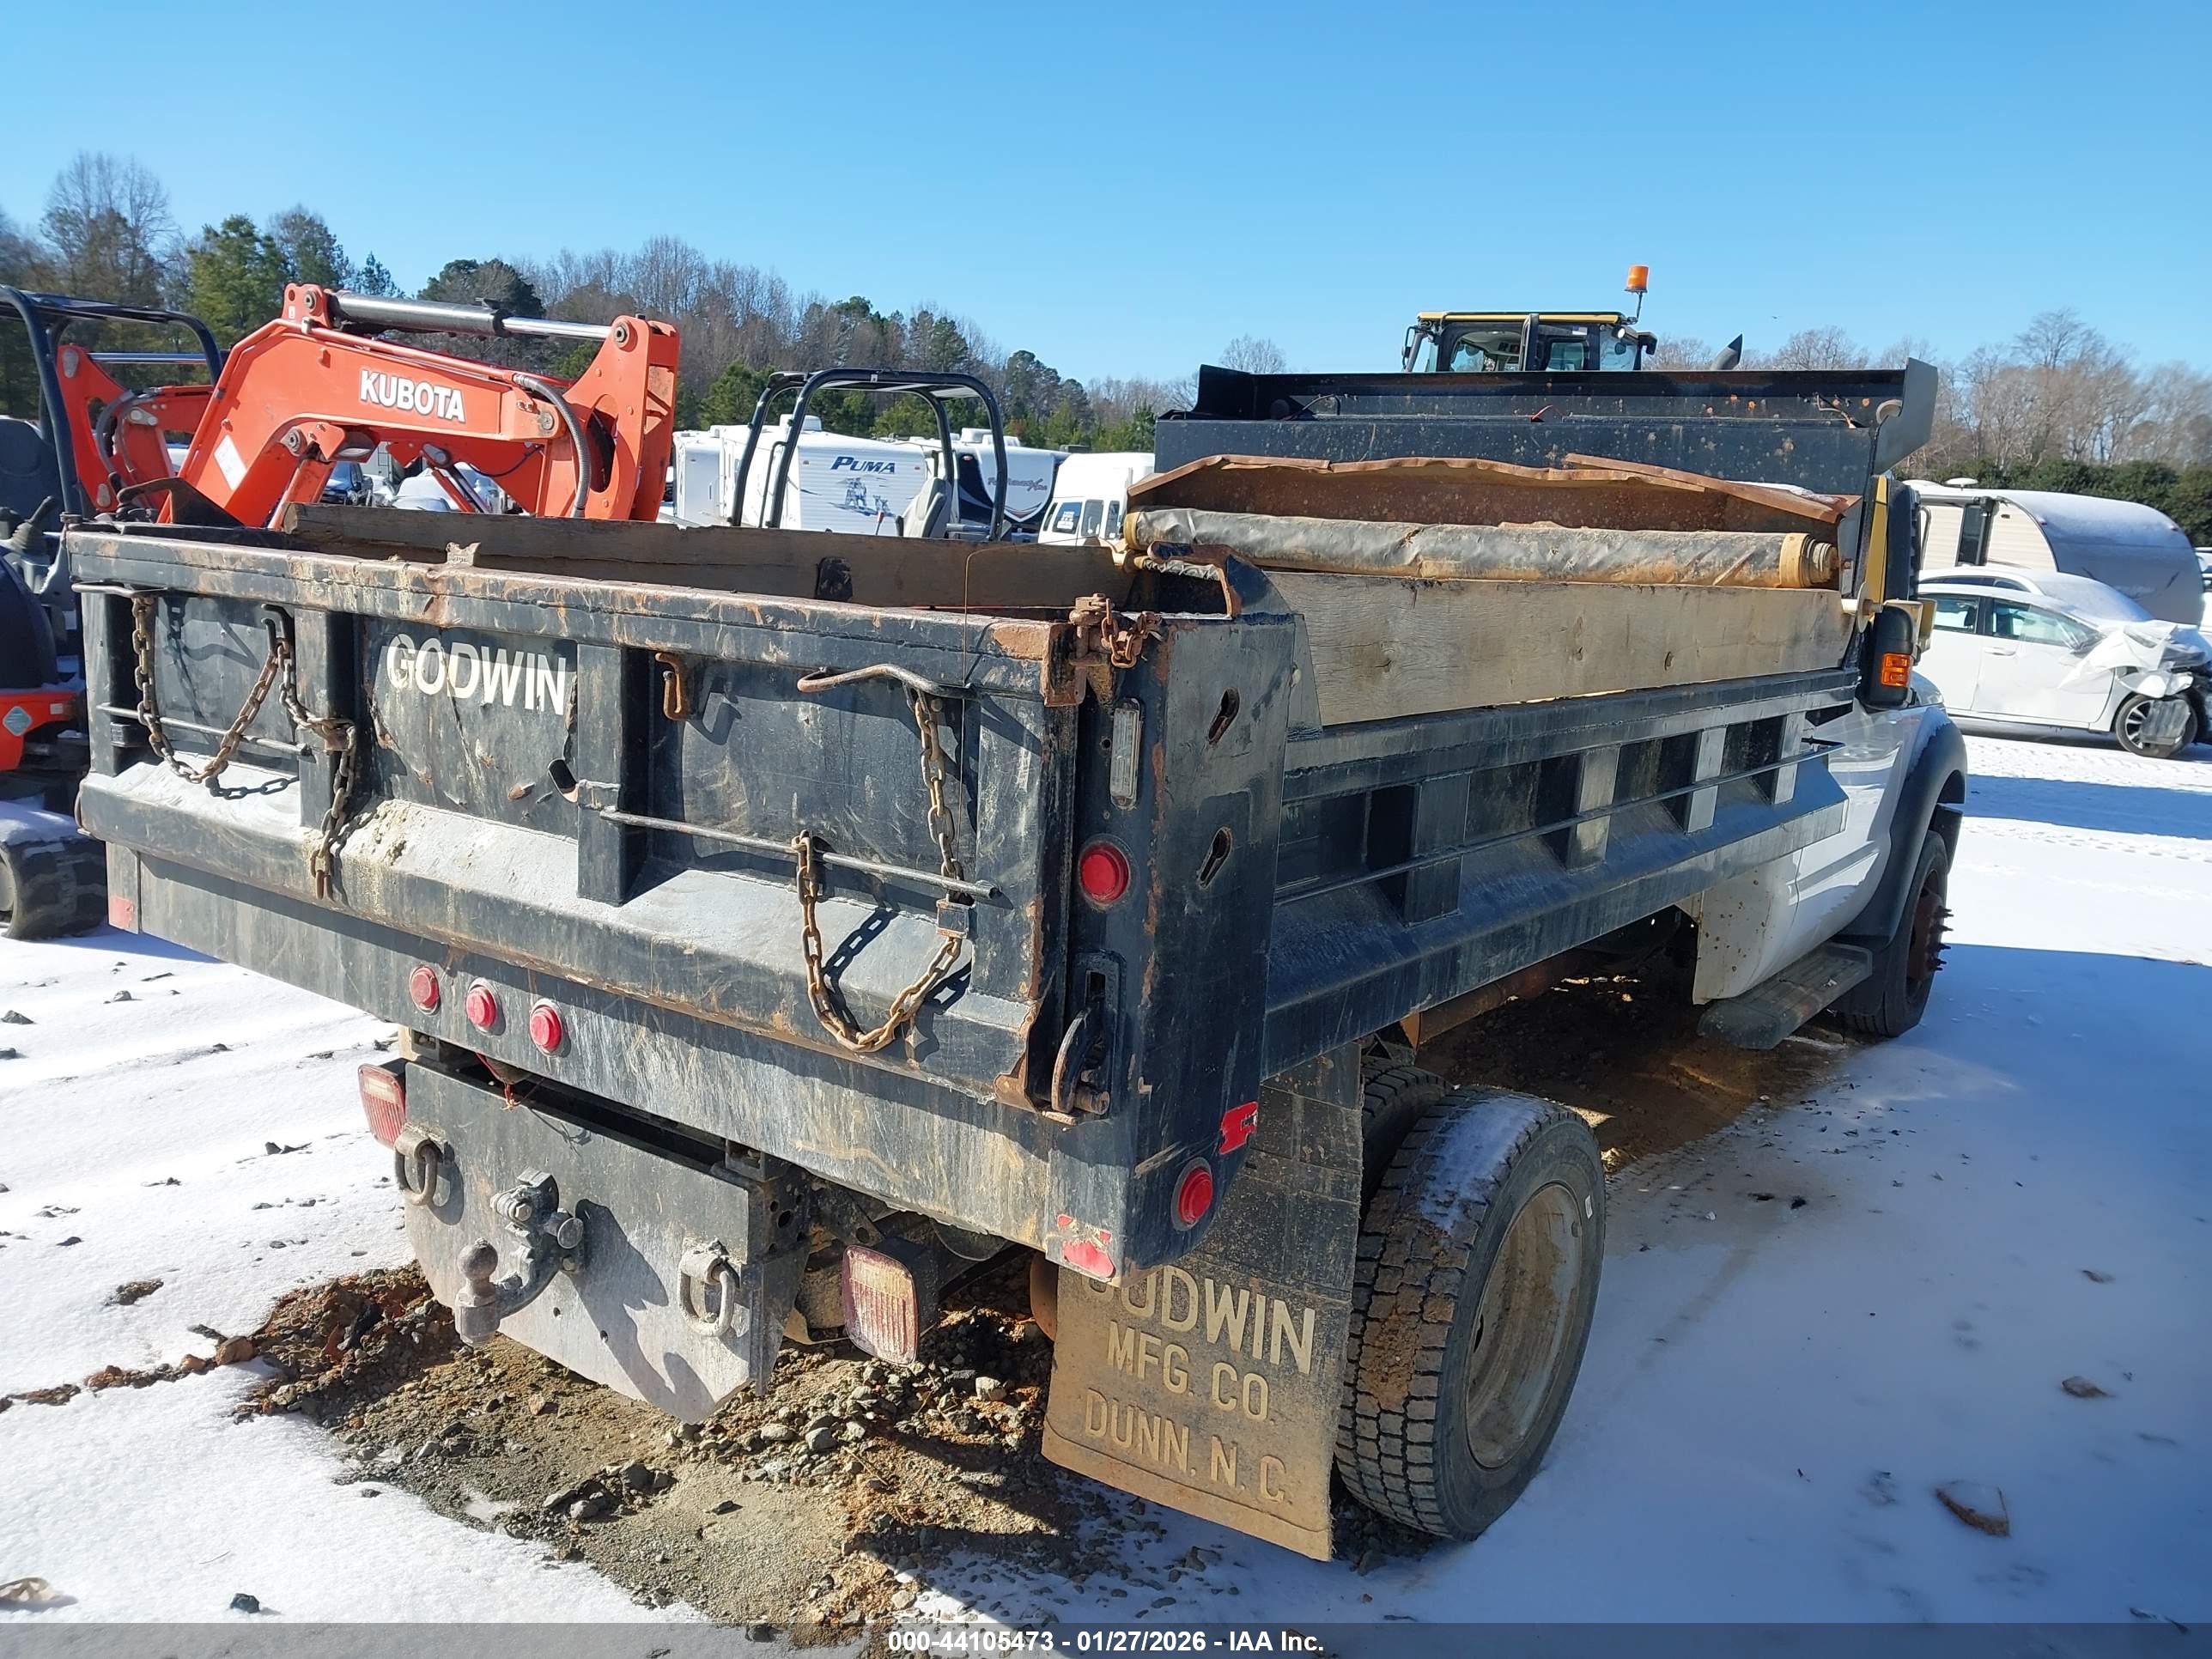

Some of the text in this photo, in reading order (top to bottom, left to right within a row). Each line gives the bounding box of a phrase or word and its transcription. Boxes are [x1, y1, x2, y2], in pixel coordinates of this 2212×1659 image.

[360, 369, 466, 424] KUBOTA
[830, 455, 896, 474] PUMA
[386, 633, 567, 716] GODWIN
[1085, 1264, 1316, 1375] ODWIN
[1106, 1320, 1276, 1426] MFG. CO.
